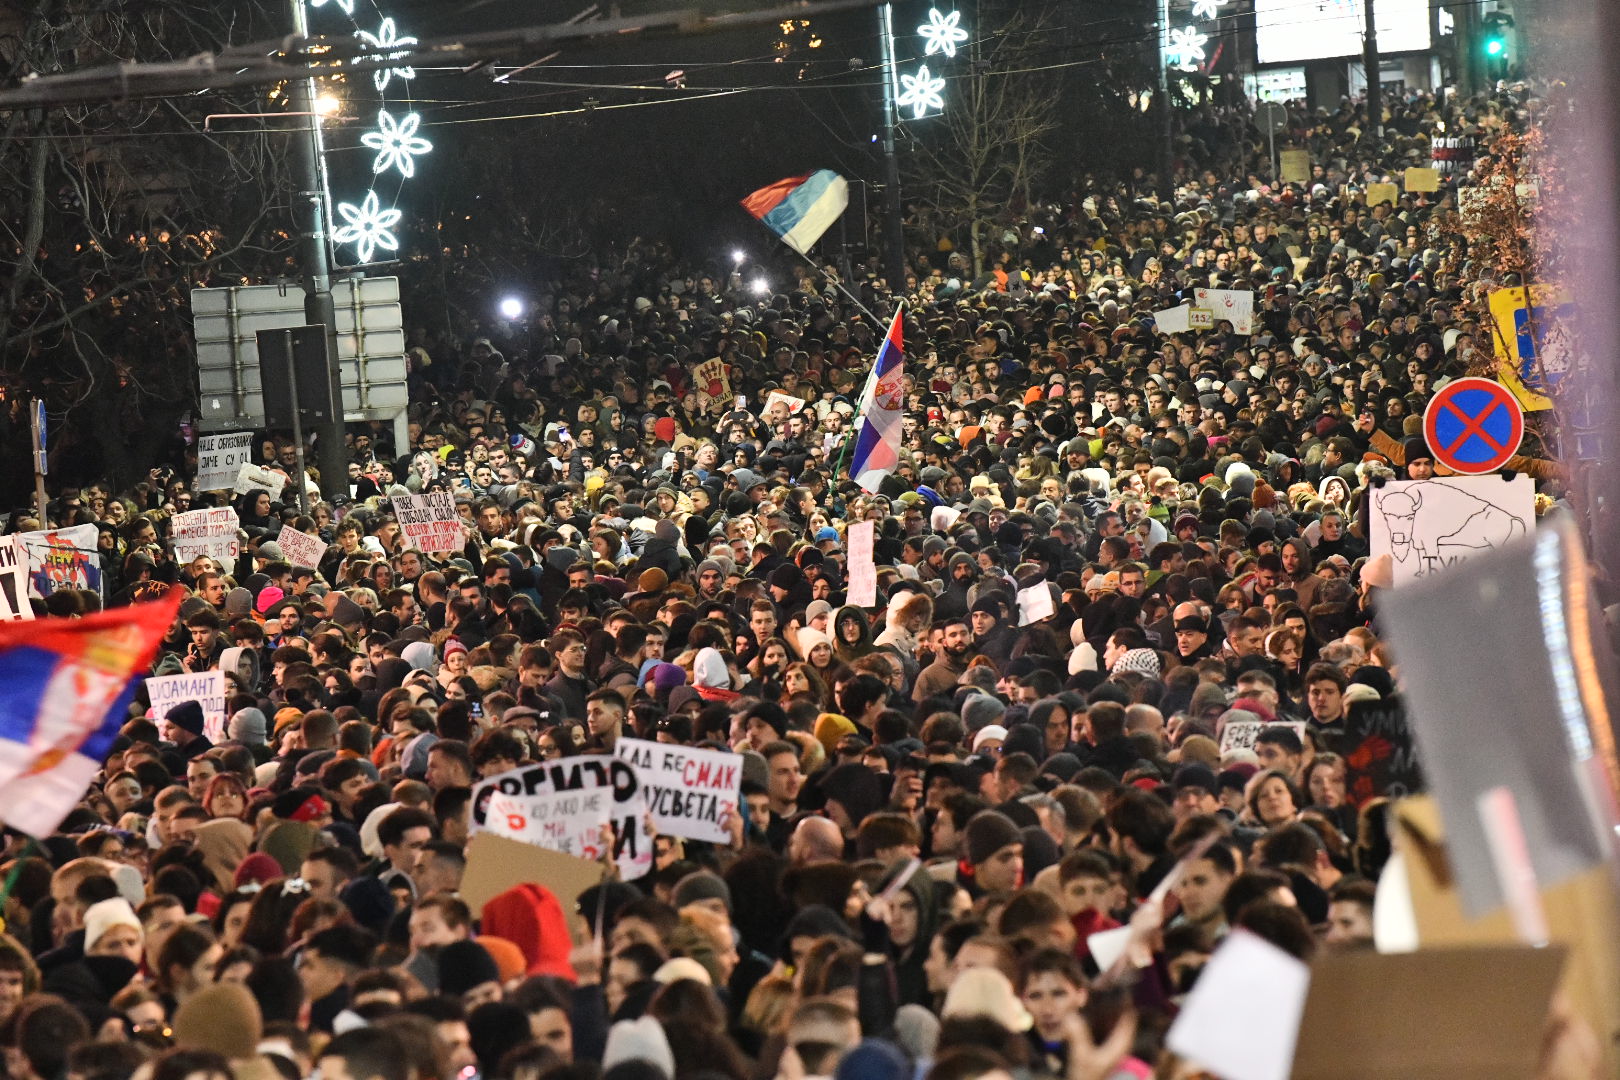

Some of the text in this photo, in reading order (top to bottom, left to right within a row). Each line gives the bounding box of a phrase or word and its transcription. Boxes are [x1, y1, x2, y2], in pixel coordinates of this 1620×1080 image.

[201, 455, 218, 469] ЈАЧЕ
[225, 454, 235, 466] СУ
[393, 492, 451, 510] ЧОВЕК ПОСТАЈЕ
[173, 512, 207, 526] СТУДЕНТИ
[399, 508, 432, 524] СЛОБОДАН
[281, 527, 317, 546] СТУДЕНТИ
[212, 542, 223, 558] ЗА
[226, 541, 239, 557] 15!
[202, 697, 224, 712] ПОД
[620, 746, 652, 769] КАД
[683, 759, 736, 790] СМАК
[552, 798, 578, 816] АКО
[582, 795, 601, 812] НЕ
